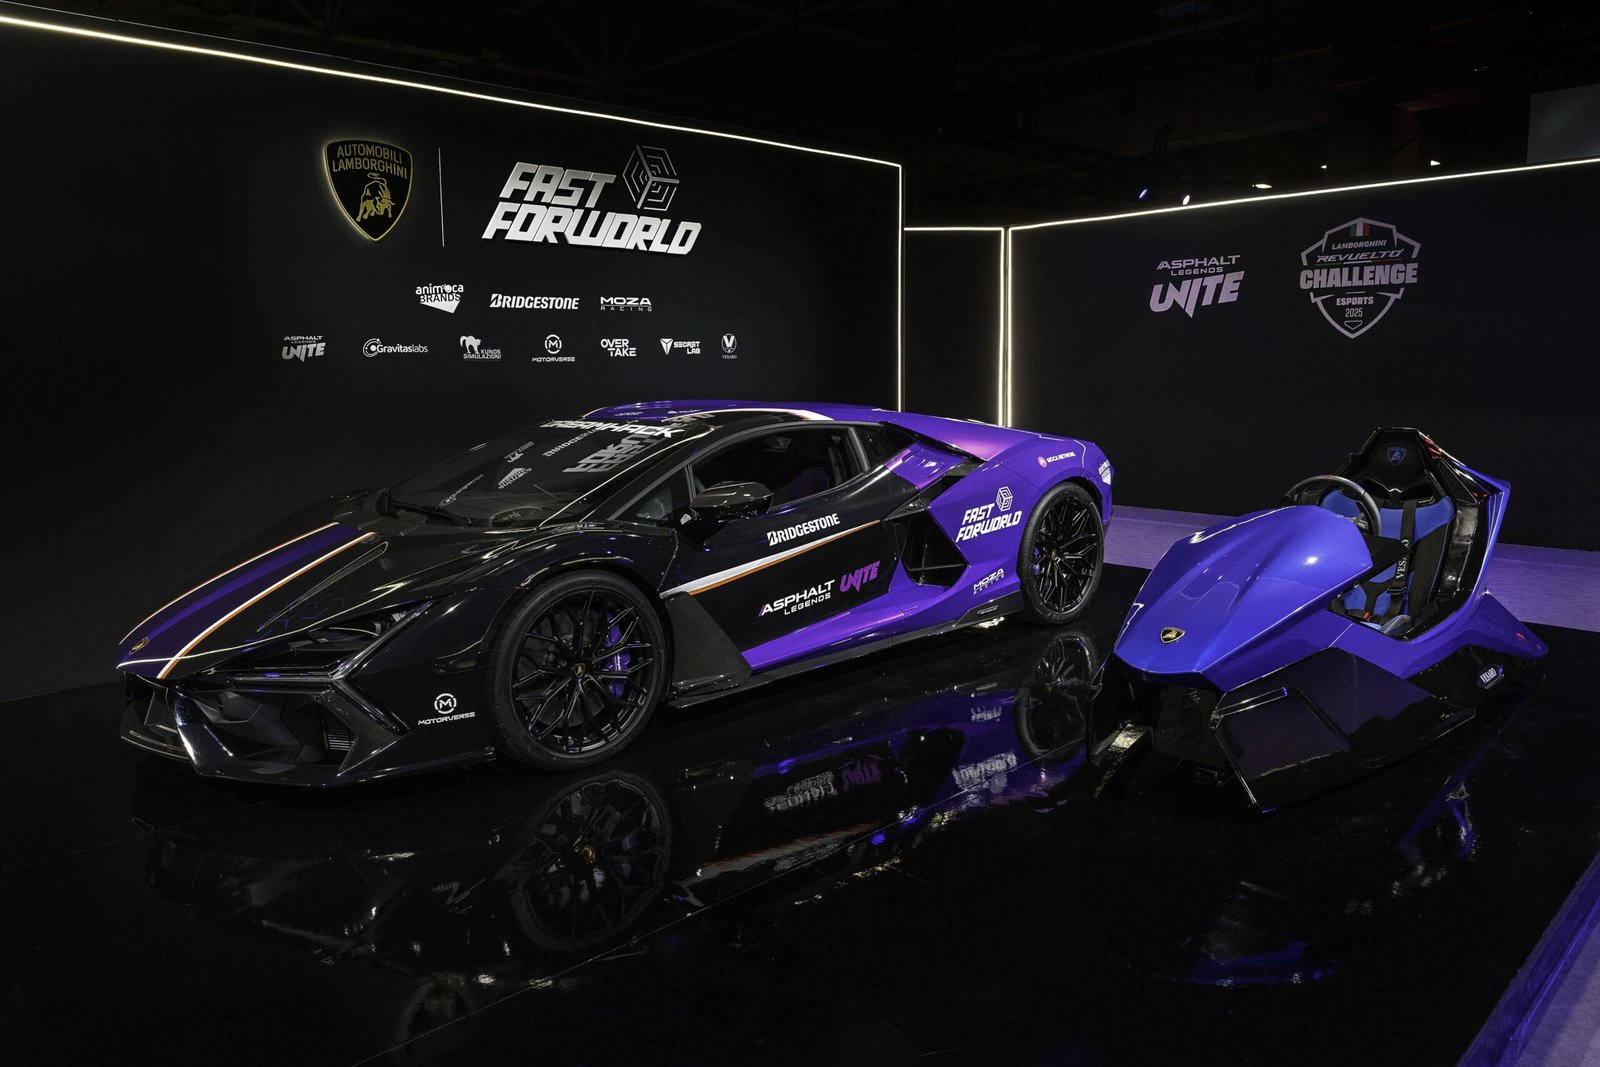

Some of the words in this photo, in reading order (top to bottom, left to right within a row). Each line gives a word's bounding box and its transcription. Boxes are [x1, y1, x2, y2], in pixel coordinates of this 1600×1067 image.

[336, 143, 402, 165] AUTOMOBILI
[332, 158, 408, 180] LAMBORGHINI
[499, 161, 617, 208] FAST
[481, 201, 702, 255] FORWORLD
[1332, 239, 1387, 250] LAMBORGHINI
[1157, 254, 1241, 270] ASPHALT
[1316, 248, 1405, 263] REVUELTO
[1171, 266, 1224, 276] LEGENDS
[1300, 262, 1419, 290] CHALLENGE
[415, 283, 464, 295] animoca
[1150, 270, 1245, 319] UNITE
[419, 293, 461, 303] BRANDS
[489, 293, 580, 310] BRIDGESTONE
[600, 296, 652, 306] MOZA
[1336, 296, 1374, 306] ESPORTS
[1345, 307, 1363, 318] 2025
[377, 343, 428, 354] Gravitaslabs
[600, 338, 629, 348] OVER
[686, 347, 701, 355] LAB
[281, 342, 326, 362] UNITE
[607, 347, 637, 357] TAKE
[961, 502, 996, 526] FAST
[766, 513, 841, 546] BRIDGESTONE
[955, 510, 1023, 543] FORWORLD
[1395, 539, 1410, 579] VESO
[839, 560, 881, 593] UNITE
[758, 579, 836, 617] ASPHALT
[784, 592, 832, 616] LEGENDS
[417, 711, 476, 726] MOTORVERSE
